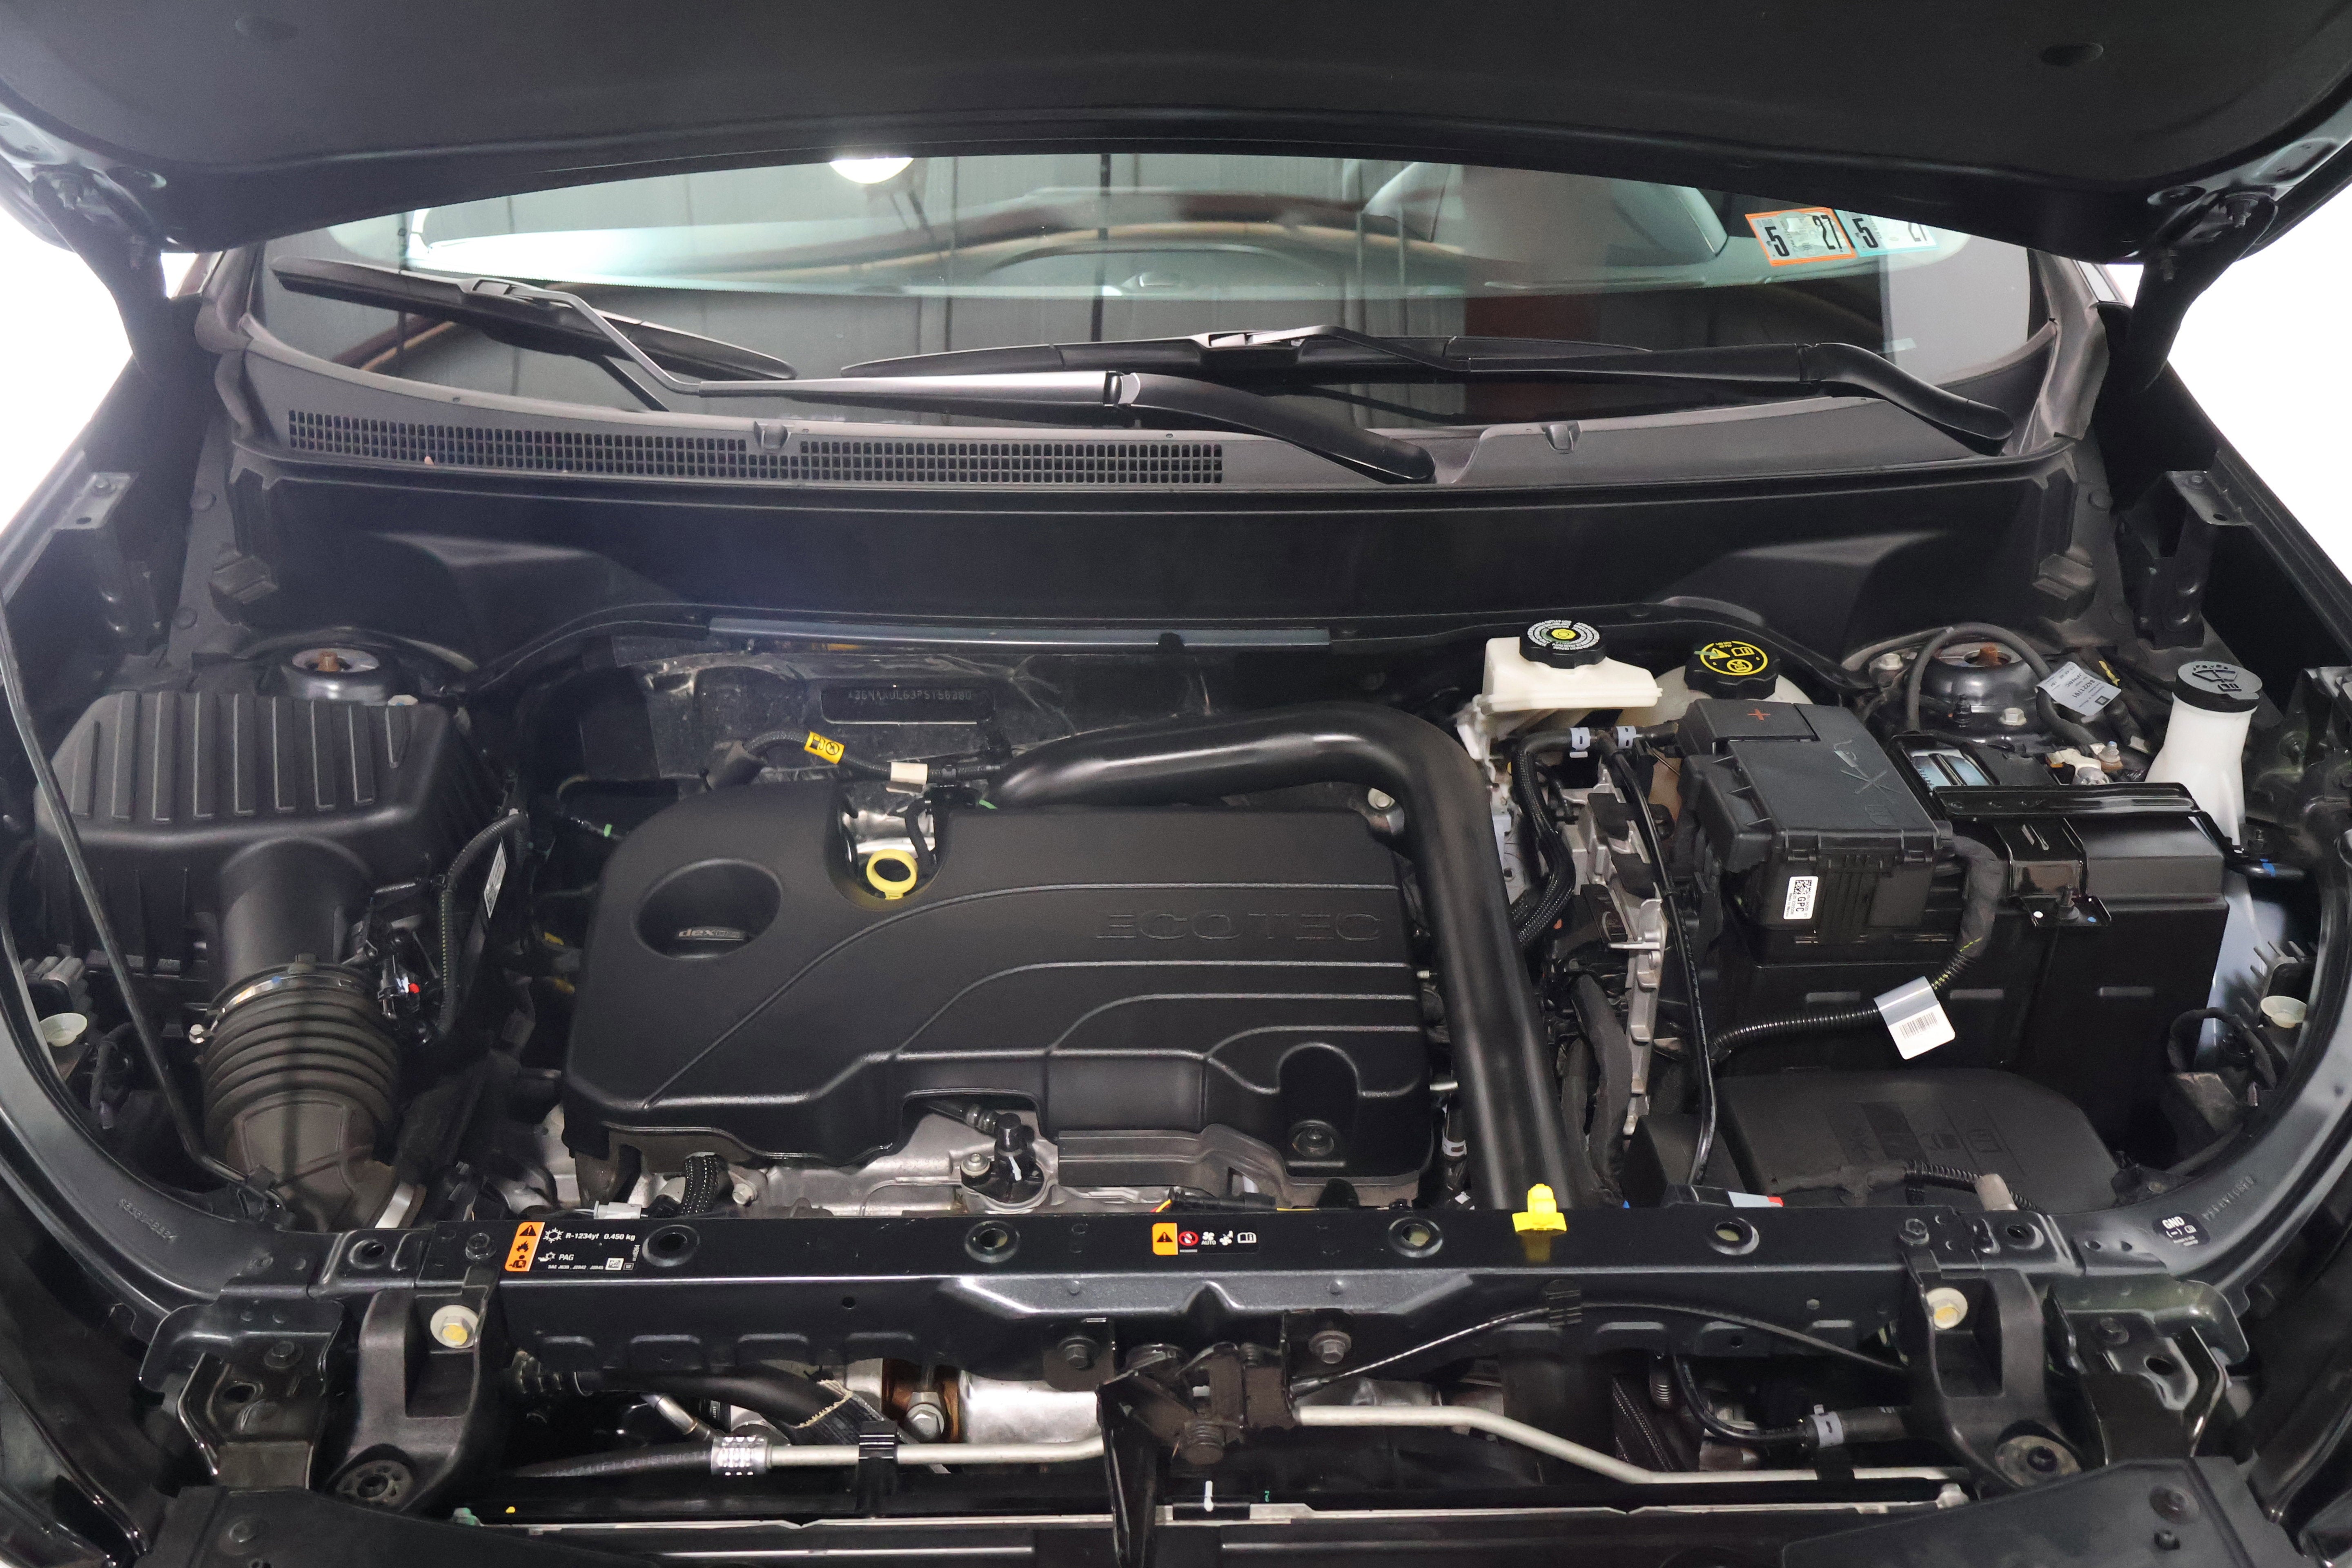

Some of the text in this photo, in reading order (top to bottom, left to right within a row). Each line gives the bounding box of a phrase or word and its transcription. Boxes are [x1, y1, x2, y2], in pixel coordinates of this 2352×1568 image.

[1764, 226, 1790, 257] 5
[1812, 214, 1842, 250] 27
[1852, 218, 1879, 248] 5
[1795, 897, 1806, 912] GPC
[1095, 909, 1383, 942] ECOTEC
[2162, 1216, 2185, 1229] GND
[565, 1232, 600, 1241] R-1234yf
[626, 1233, 636, 1241] kg
